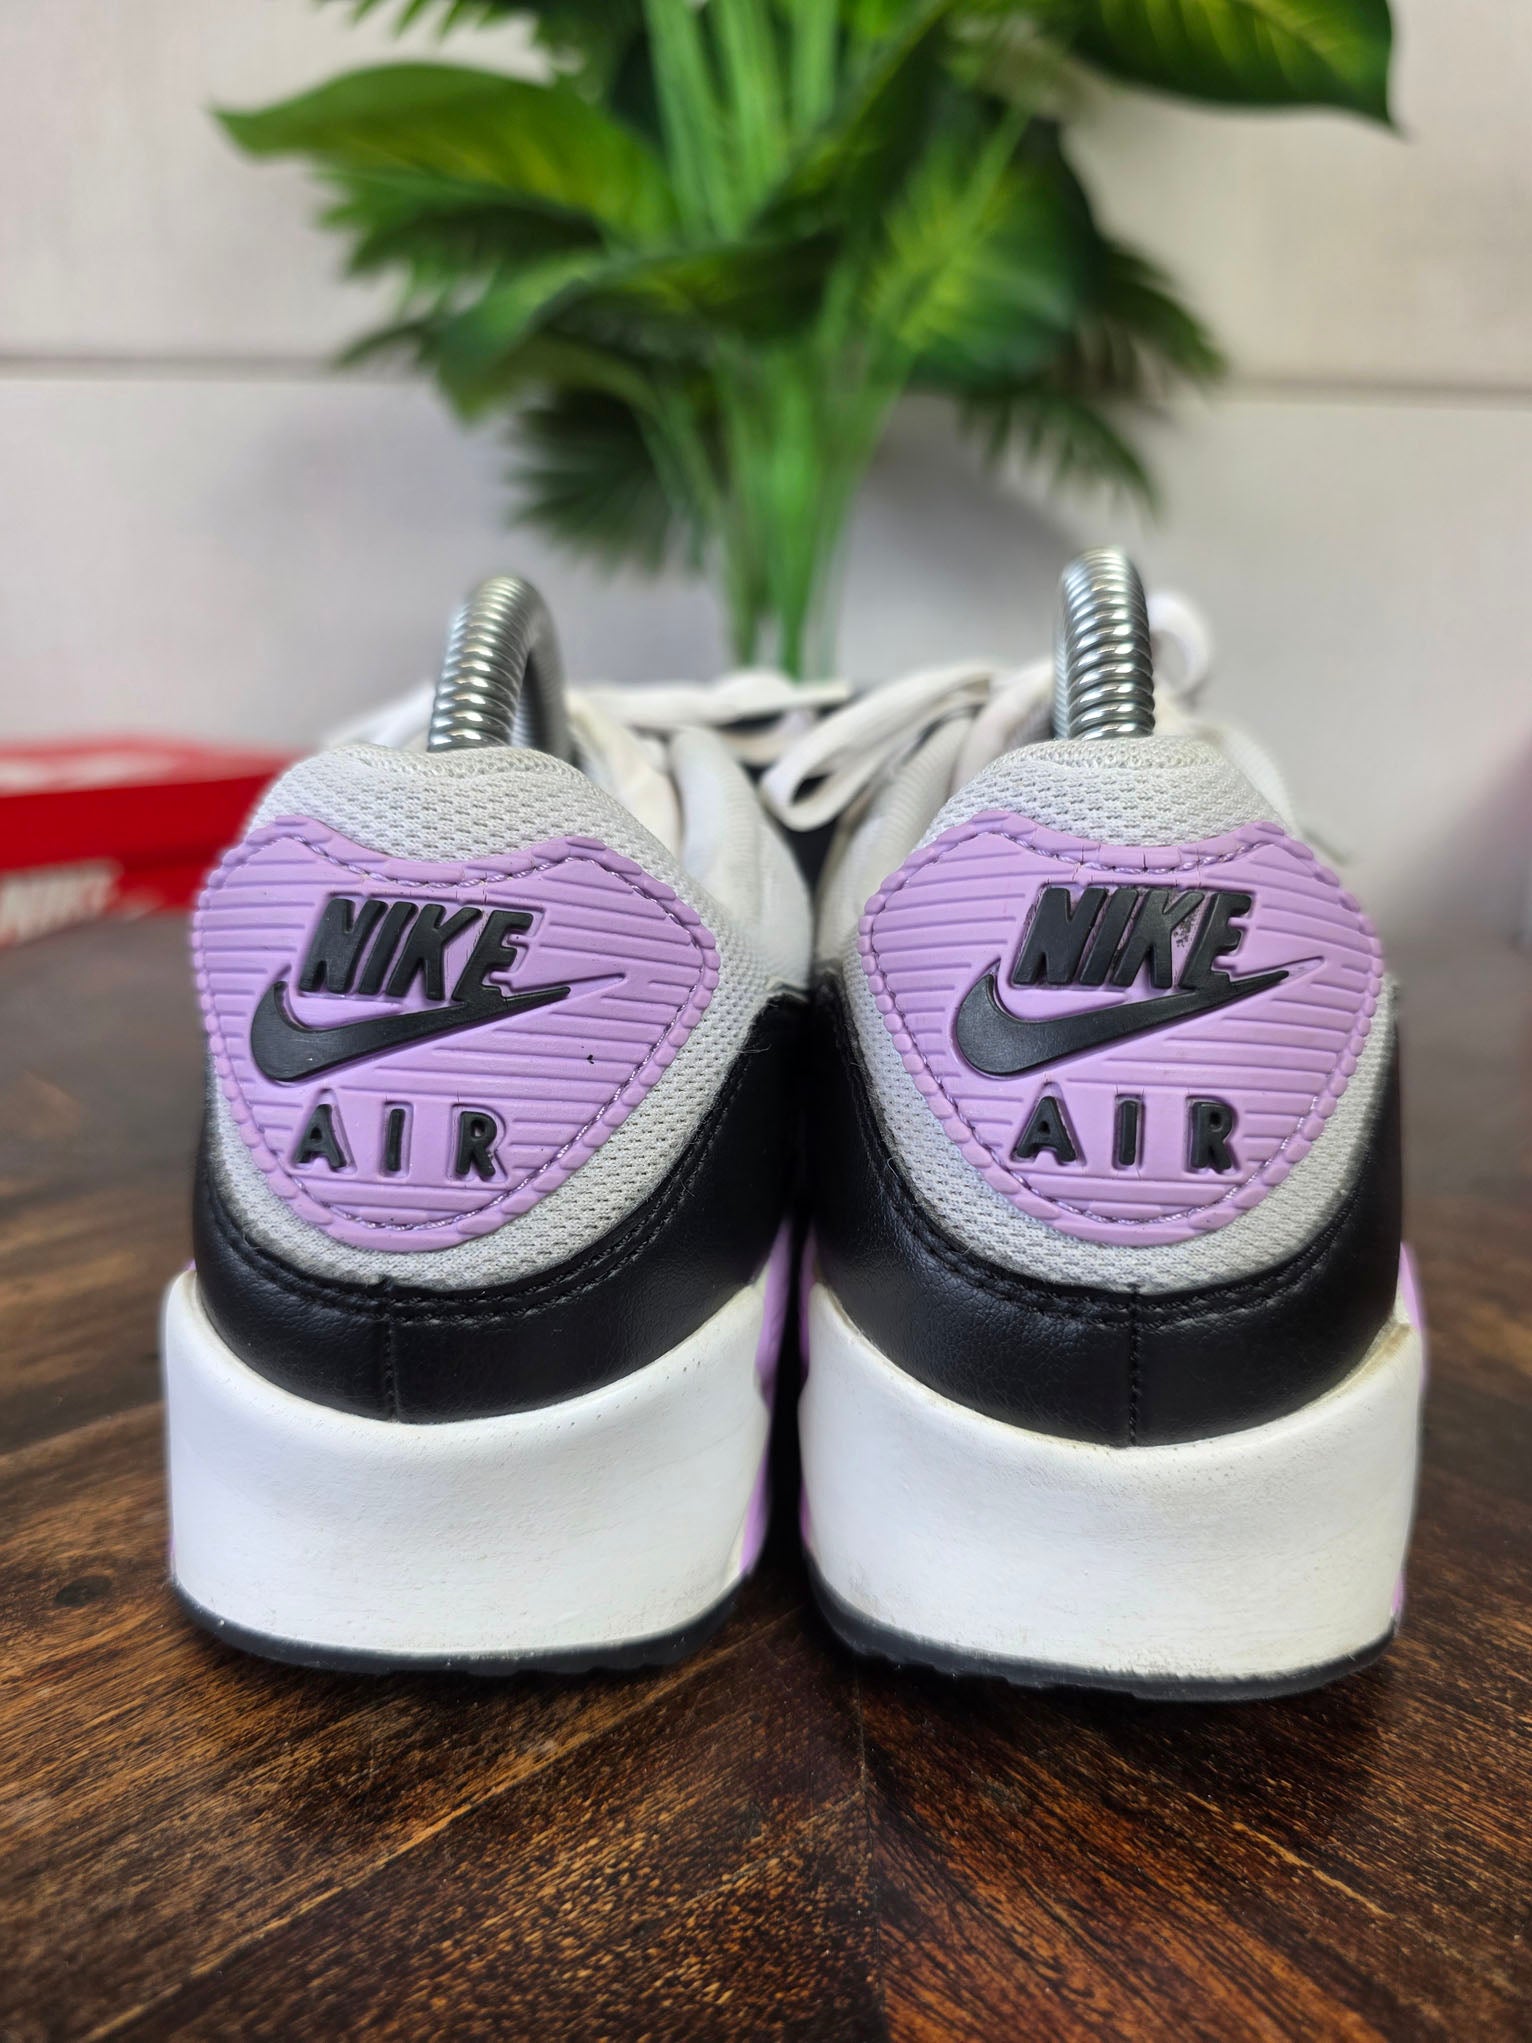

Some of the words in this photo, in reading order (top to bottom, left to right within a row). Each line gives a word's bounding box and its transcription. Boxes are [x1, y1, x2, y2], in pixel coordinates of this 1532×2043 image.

[301, 898, 533, 1001] NIKE
[1012, 887, 1253, 990] NIKE
[298, 1103, 497, 1177] AIR
[1014, 1095, 1238, 1172] AIR
